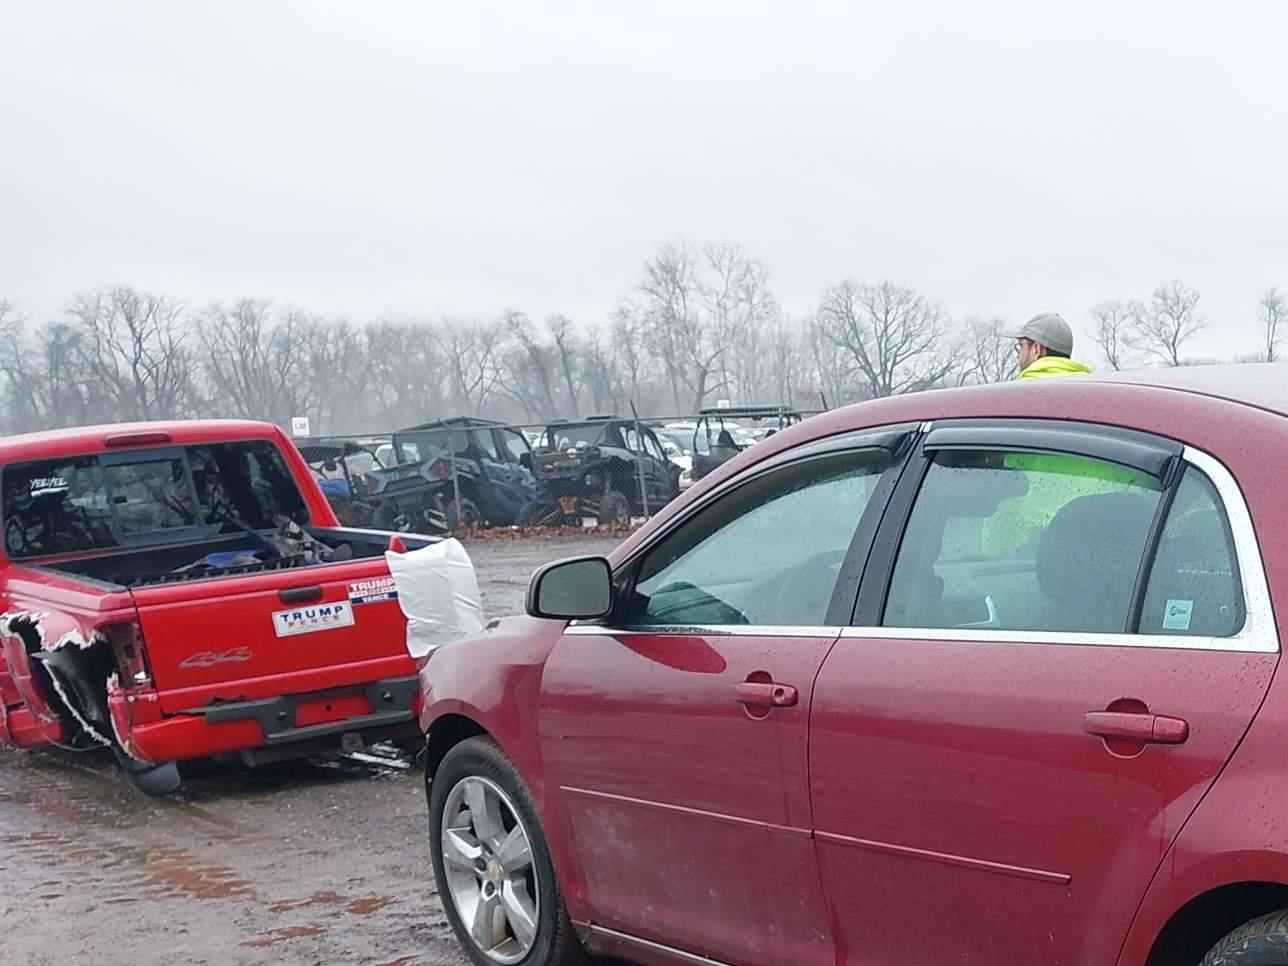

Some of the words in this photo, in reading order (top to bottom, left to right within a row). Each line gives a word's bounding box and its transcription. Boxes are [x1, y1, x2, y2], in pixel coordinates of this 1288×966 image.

[350, 578, 394, 591] TRUMP
[280, 605, 344, 622] TRUMP
[288, 615, 340, 628] PENCE
